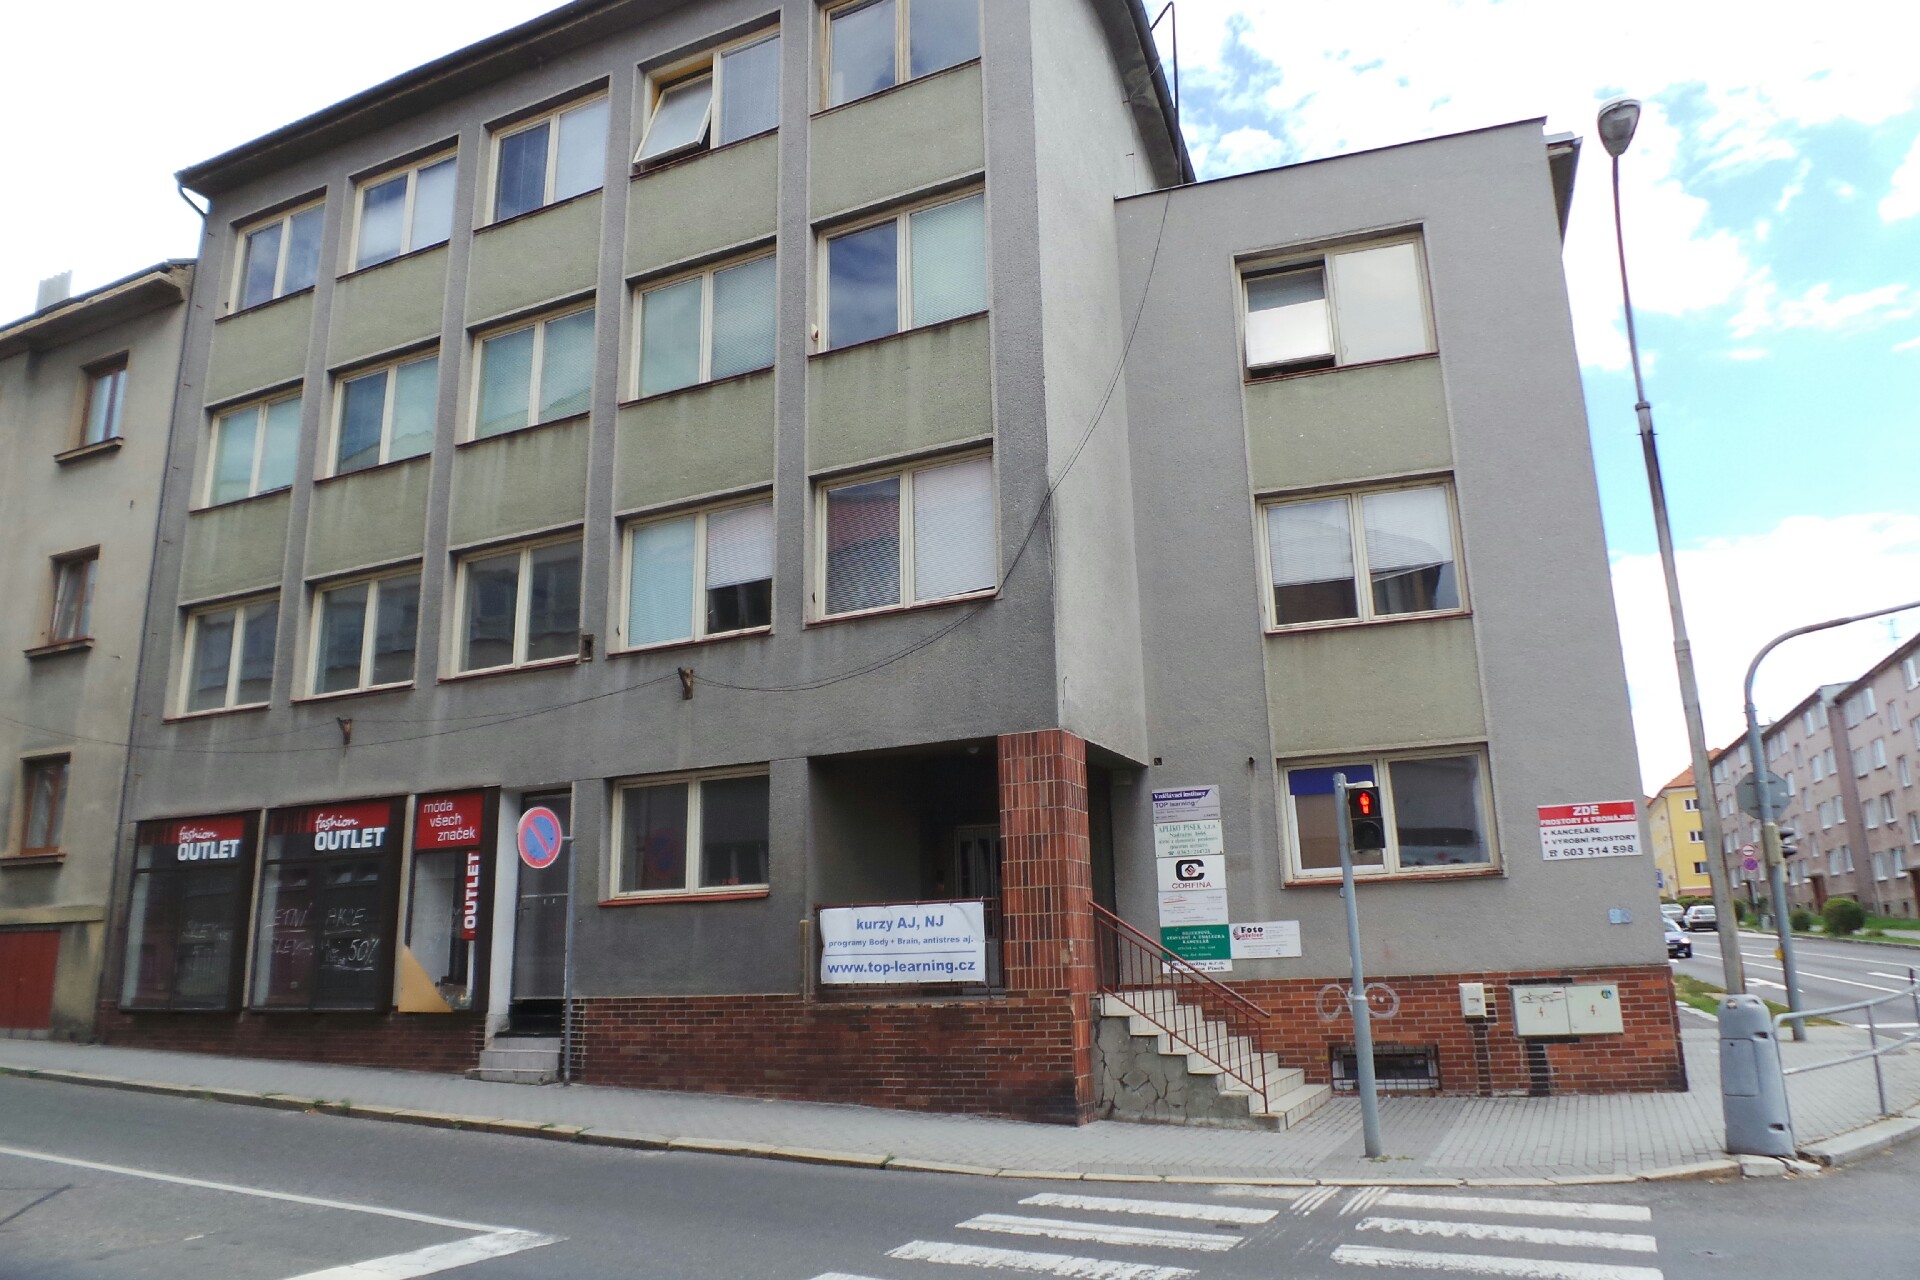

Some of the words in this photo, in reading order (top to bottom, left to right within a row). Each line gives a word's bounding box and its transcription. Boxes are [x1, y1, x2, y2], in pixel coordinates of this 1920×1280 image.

[1572, 805, 1600, 816] ZDE
[314, 813, 358, 832] fashion
[430, 813, 462, 827] všech
[179, 826, 216, 843] fashion
[314, 827, 385, 851] OUTLET
[437, 827, 476, 841] značek
[1591, 834, 1636, 842] PROSTORY
[178, 839, 240, 861] OUTLET
[1563, 847, 1584, 856] 603
[1587, 846, 1609, 855] 514
[1613, 844, 1634, 853] 598
[464, 853, 480, 929] OUTLET
[1171, 881, 1212, 889] CORFINA
[856, 918, 893, 932] kurzy
[897, 917, 920, 930] AJ,
[925, 915, 944, 928] NJ
[828, 939, 866, 948] programy
[869, 938, 889, 947] Body
[897, 937, 921, 945] Brain,
[923, 935, 960, 944] antistres
[963, 935, 974, 943] aj.
[828, 960, 976, 975] www.top-learning.cz
